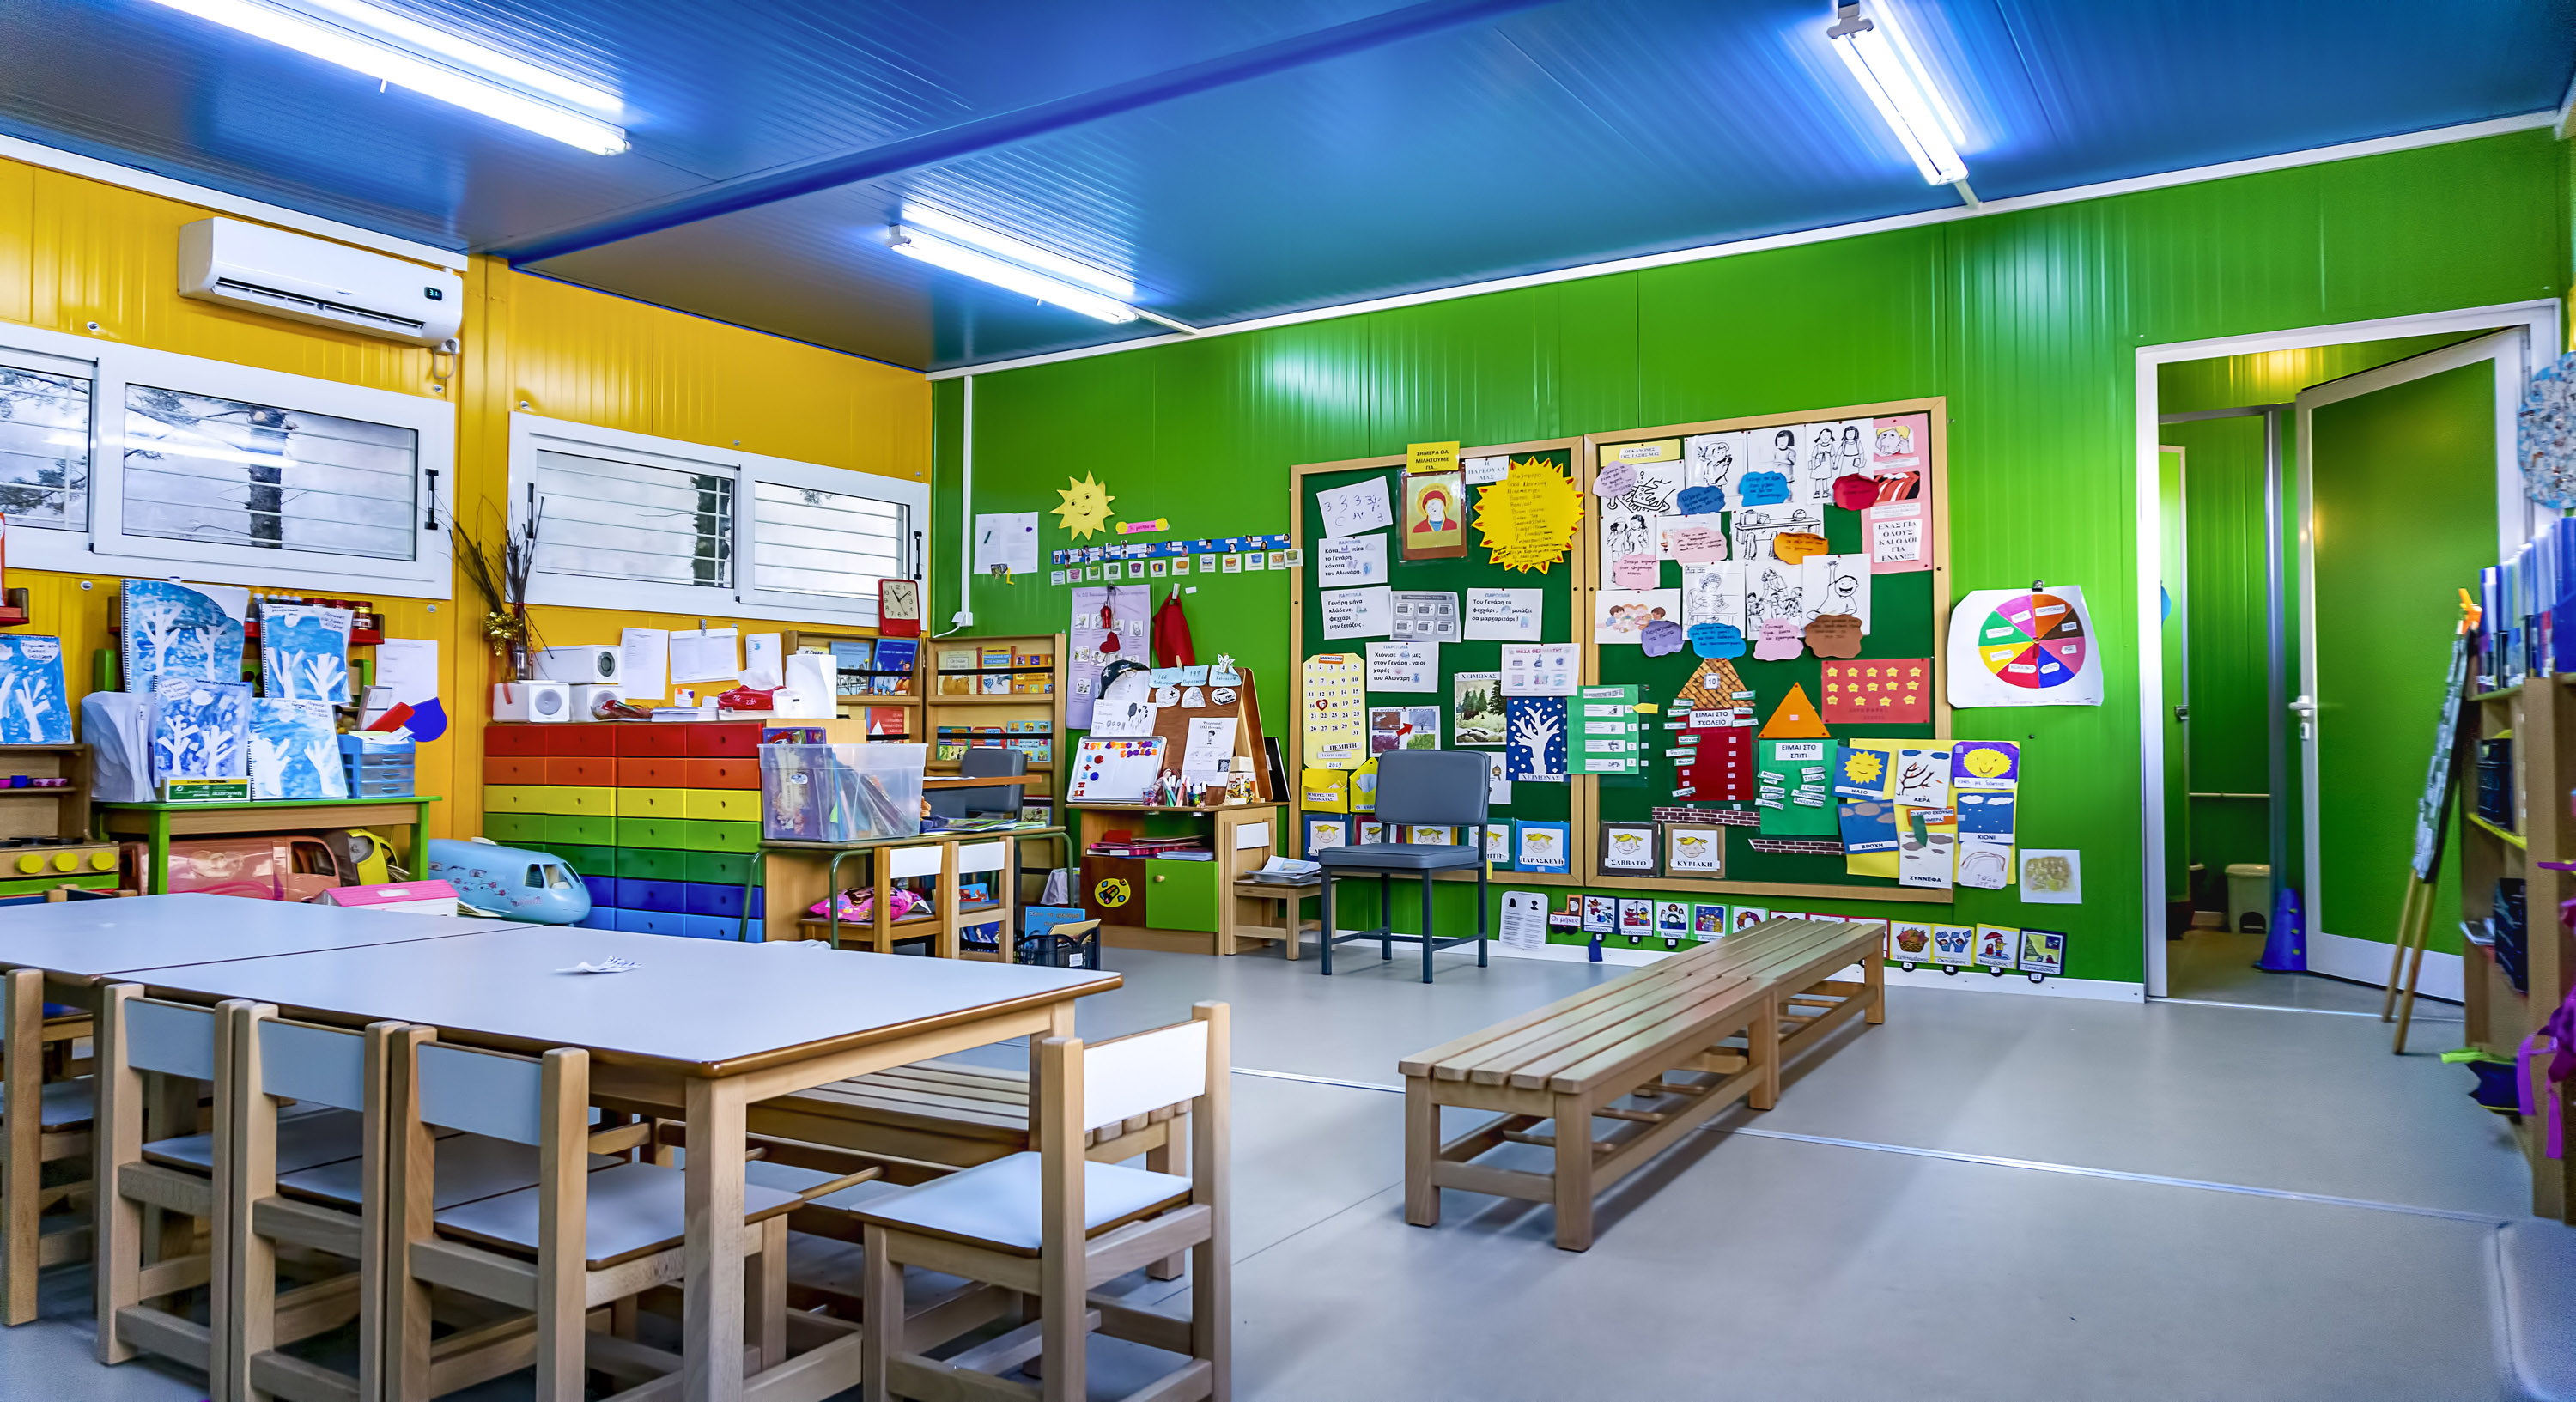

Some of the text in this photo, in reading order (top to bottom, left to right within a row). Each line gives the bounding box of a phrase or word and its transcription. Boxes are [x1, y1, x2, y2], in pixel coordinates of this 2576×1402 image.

[1354, 495, 1362, 506] 3
[1882, 529, 1913, 537] ΟΛΟΥΣ
[1895, 537, 1917, 545] ΟΛΟΙ
[1329, 743, 1358, 751] ΠΕΜΠΤΗ
